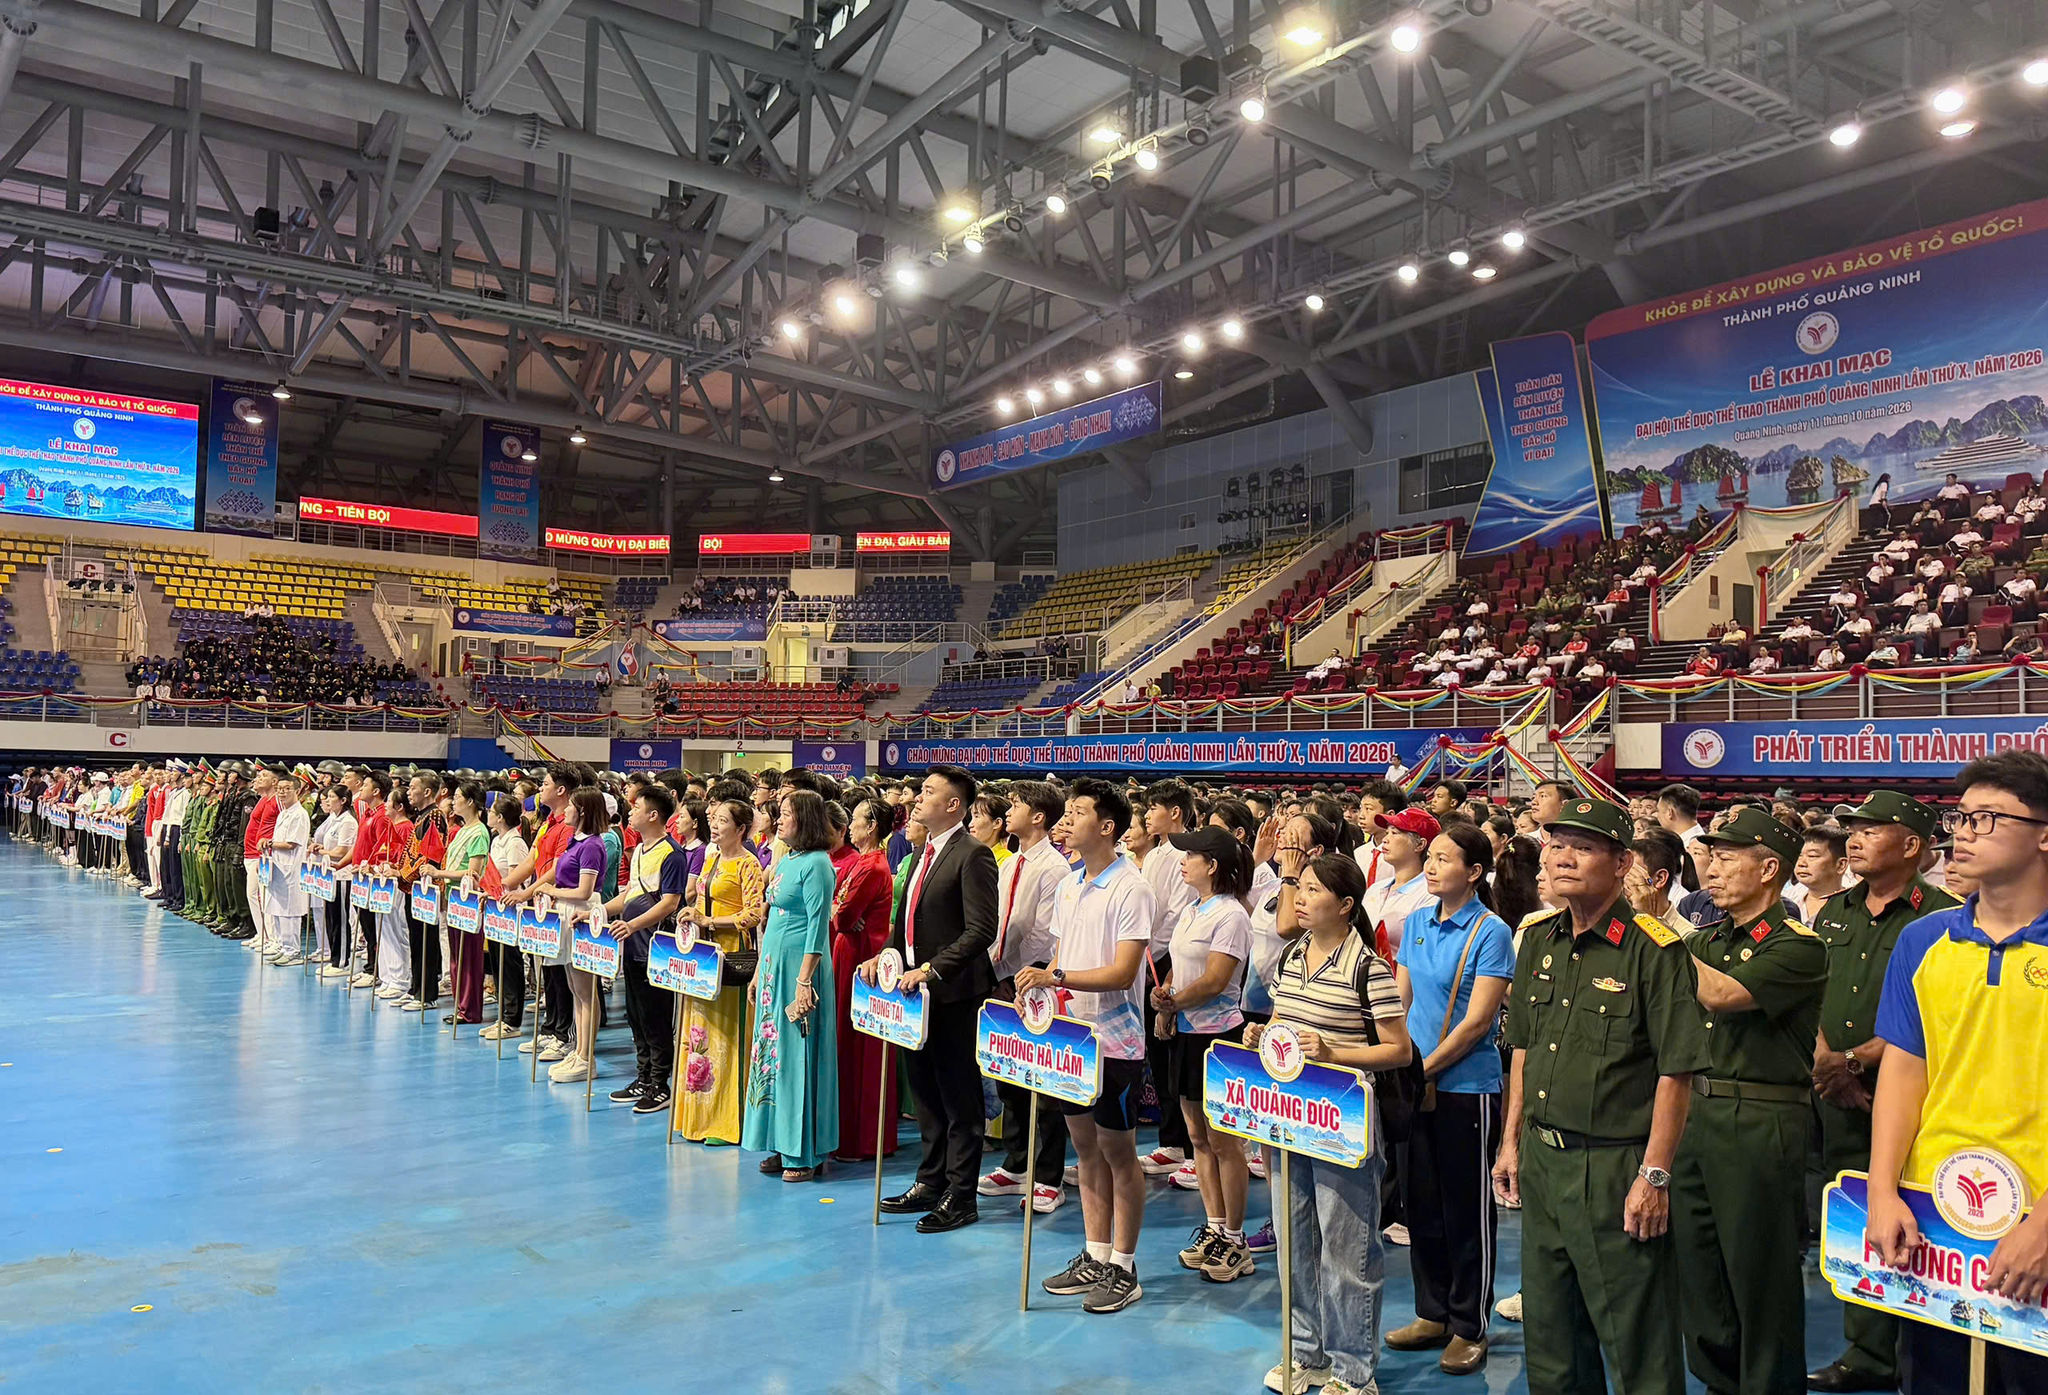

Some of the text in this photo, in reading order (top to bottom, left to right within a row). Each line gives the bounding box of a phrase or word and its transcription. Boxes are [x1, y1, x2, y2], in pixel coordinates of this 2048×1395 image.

[1645, 216, 2023, 322] KHỎE ĐỂ XÂY DỰNG VÀ BẢO VỆ TỔ QUỐC!
[1722, 270, 1921, 327] THÀNH PHỐ QUẢNG NINH
[1750, 348, 1891, 392] LỄ KHAI MẠC
[1636, 348, 2043, 440] ĐẠI HỘI THỂ DỤC THỂ THAO THÀNH PHỐ QUẢNG NINH LẦN THỨ X, NĂM 2026
[36, 403, 63, 412] THÀNH
[114, 414, 134, 422] NINH
[1809, 418, 1821, 429] 11
[1850, 410, 1863, 421] 10
[1864, 406, 1885, 419] năm
[1887, 400, 1912, 416] 2026
[64, 441, 91, 453] KHAI
[367, 509, 390, 523] BỘ!
[555, 533, 589, 547] MỪNG
[591, 535, 614, 549] QUÝ
[628, 539, 646, 551] ĐẠI
[704, 537, 722, 551] BỘ!
[898, 534, 924, 546] GIÀU
[83, 564, 96, 578] C
[110, 732, 127, 747] C
[737, 740, 743, 750] 2
[1753, 729, 1814, 763] PHÁT
[1818, 724, 1891, 763] TRIỂN
[1897, 728, 1988, 763] THÀNH
[907, 736, 1396, 767] CHÀO MỪNG ĐẠI HỘI THỂ DỤC THỂ THAO THÀNH PHỐ QUẢNG NINH LẦN THỨ X, NĂM 2026!
[668, 956, 684, 977] PHỤ
[869, 995, 890, 1019] TRỌNG
[989, 1031, 1035, 1064] PHƯỜNG
[1037, 1042, 1053, 1069] HÀ
[1225, 1078, 1342, 1132] XÃ QUẢNG ĐỨC
